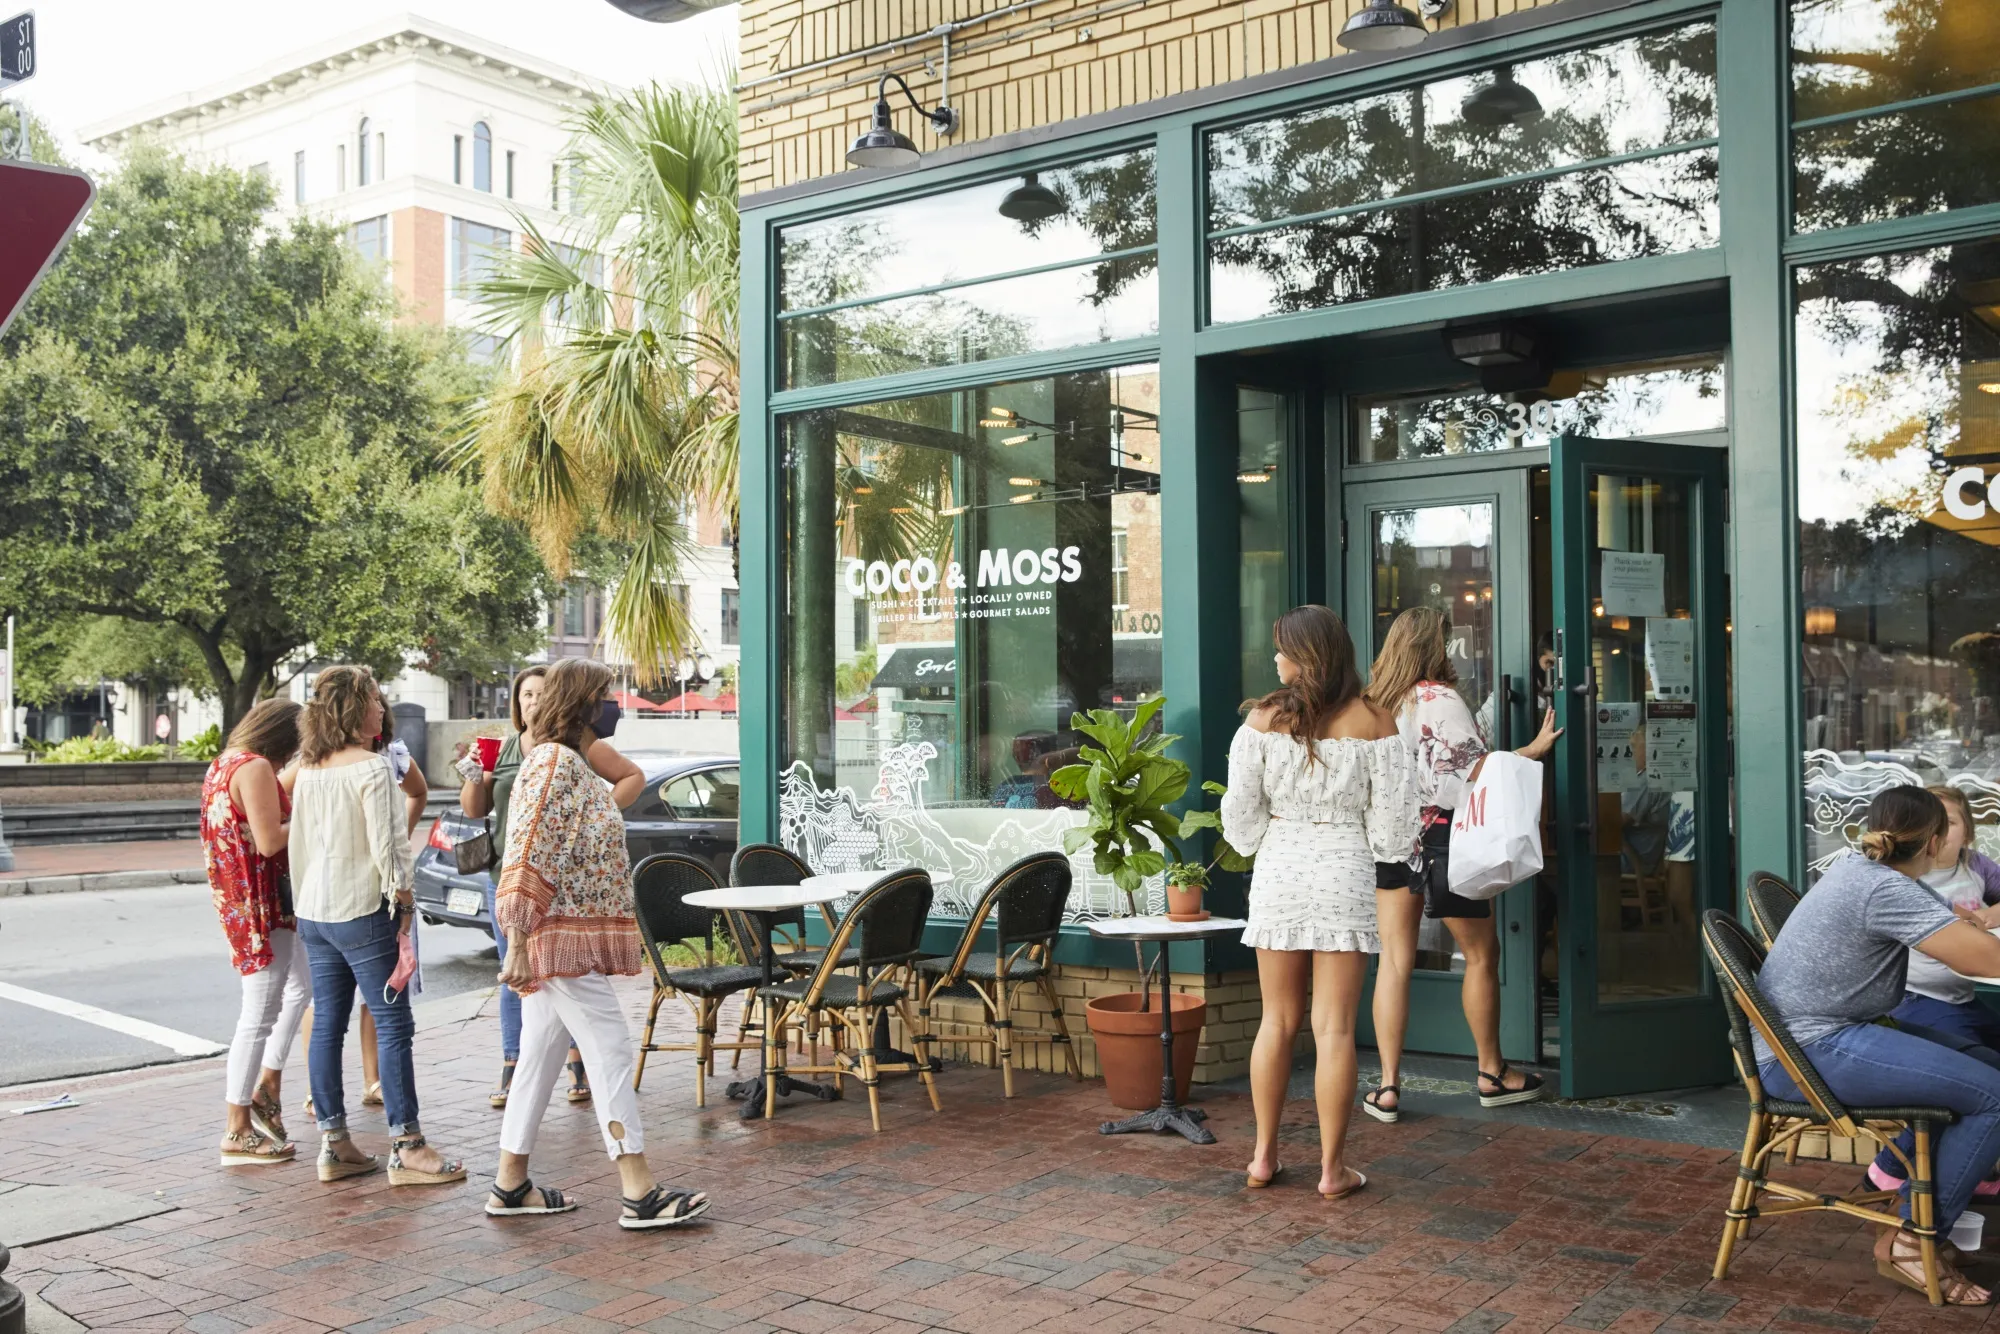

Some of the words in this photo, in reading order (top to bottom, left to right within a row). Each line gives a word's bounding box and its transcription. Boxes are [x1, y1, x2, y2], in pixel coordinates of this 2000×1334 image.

[18, 18, 31, 46] ST
[18, 46, 32, 75] 00
[1505, 399, 1554, 437] 30
[845, 556, 937, 596] COCO
[946, 561, 967, 589] &
[977, 546, 1082, 587] MOSS
[871, 599, 897, 609] SUSHI
[908, 596, 958, 608] COCKTAILS
[970, 592, 1012, 604] LOCALLY
[1016, 590, 1052, 602] OWNED
[871, 613, 905, 624] GRILLED
[909, 612, 927, 622] RIE
[969, 607, 1012, 619] GOURMET
[1016, 606, 1051, 617] SALADS
